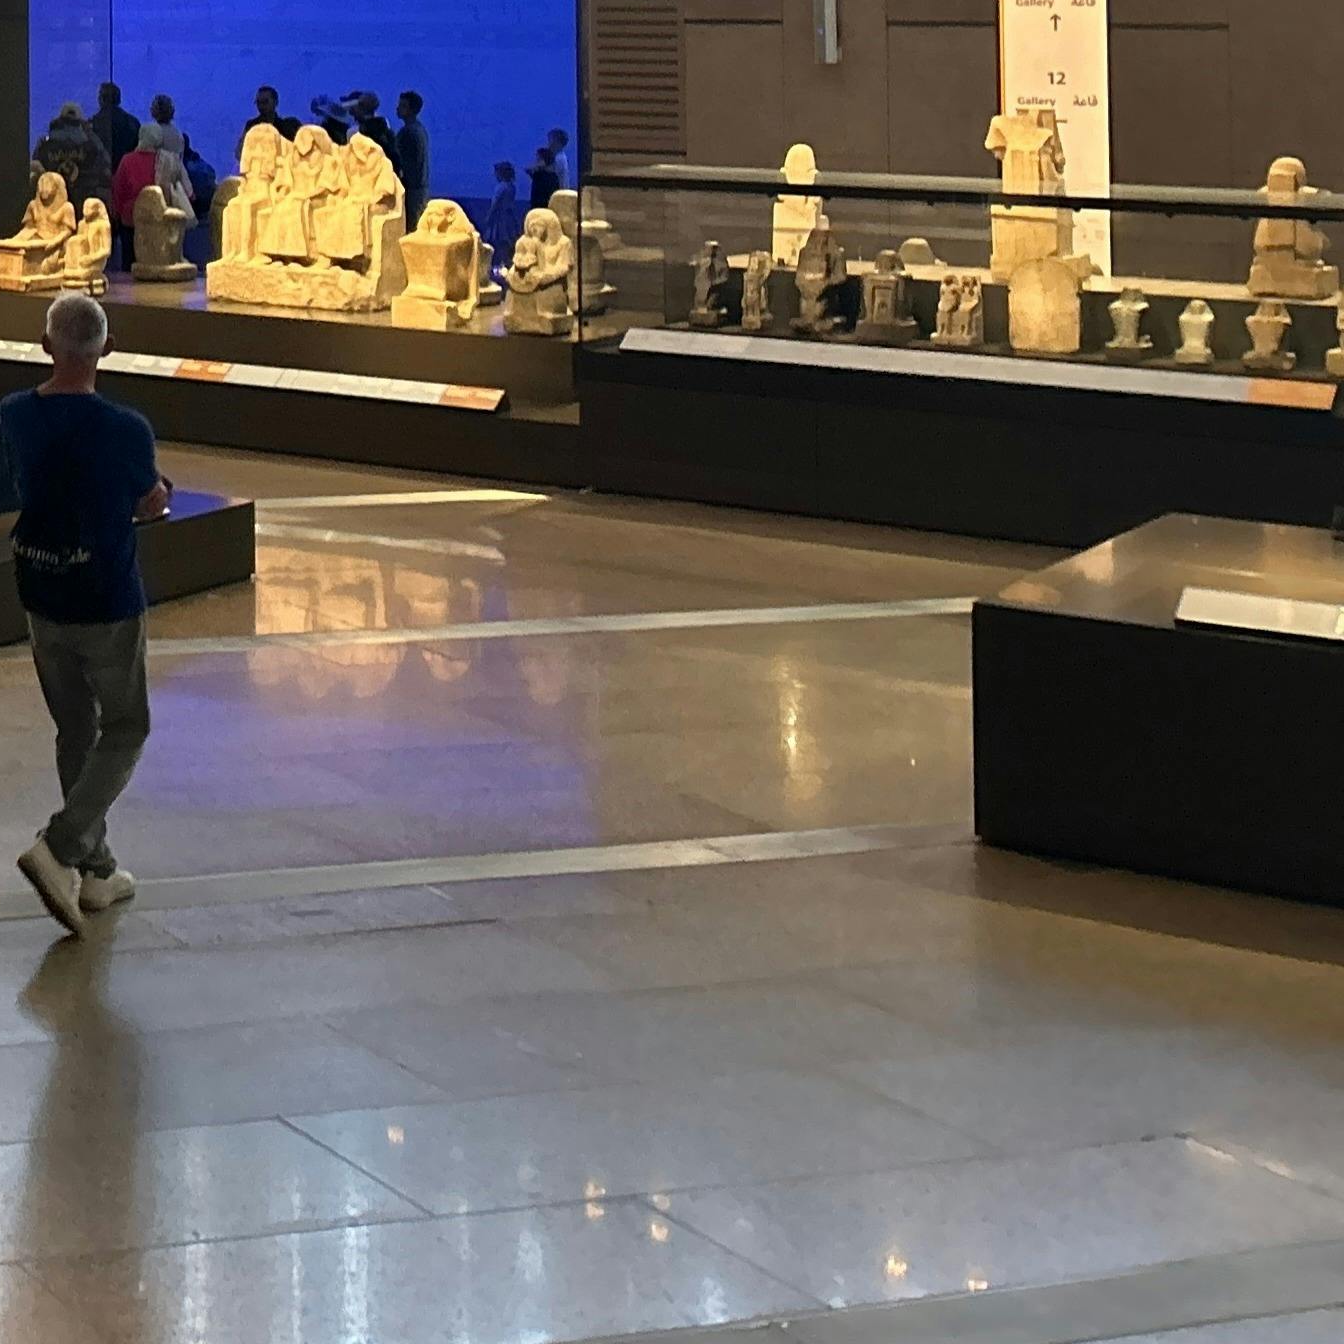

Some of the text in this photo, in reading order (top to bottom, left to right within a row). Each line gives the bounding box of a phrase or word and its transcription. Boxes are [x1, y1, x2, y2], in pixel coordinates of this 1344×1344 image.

[1047, 72, 1067, 86] 12
[1017, 96, 1057, 108] Gallery
[1072, 94, 1099, 107] قاعة
